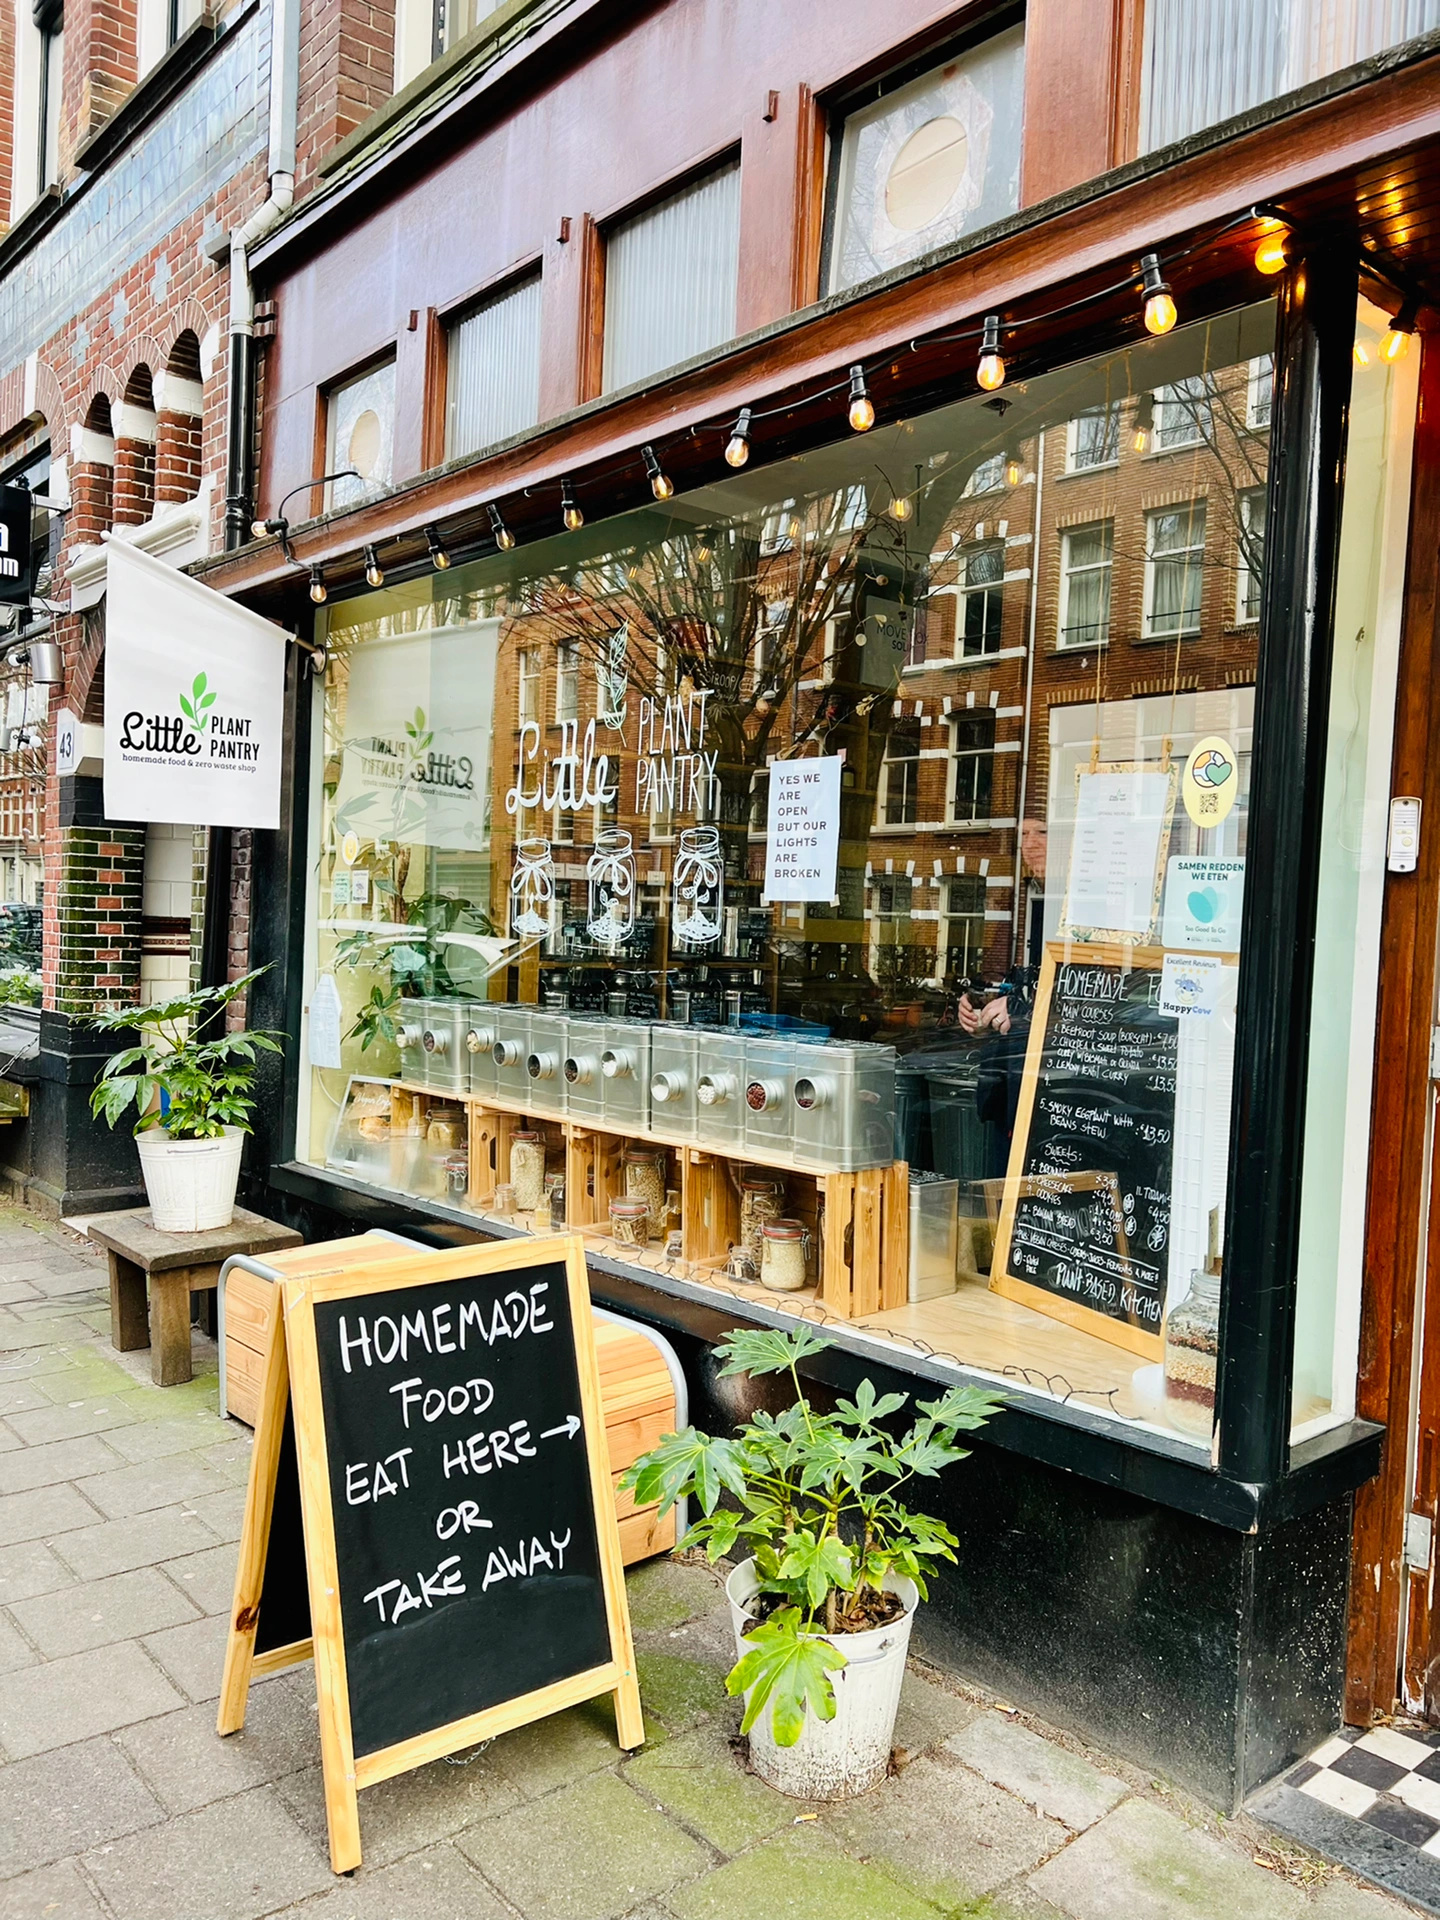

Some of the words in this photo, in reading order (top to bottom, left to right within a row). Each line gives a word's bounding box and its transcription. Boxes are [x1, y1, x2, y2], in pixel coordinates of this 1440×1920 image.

[211, 715, 252, 737] PLANT
[638, 689, 715, 756] PLANT
[119, 711, 202, 755] Little
[210, 739, 260, 761] PANTRY
[59, 732, 72, 759] 43
[122, 753, 167, 765] homemade
[168, 757, 186, 767] food
[188, 759, 194, 767] &
[195, 760, 213, 769] zero
[213, 763, 237, 771] waste
[238, 763, 257, 774] shop
[505, 717, 616, 815] Little
[635, 749, 719, 814] PANTRY
[779, 774, 800, 785] YES
[803, 773, 821, 783] WE
[778, 790, 801, 801] ARE
[777, 806, 808, 817] OPEN
[777, 822, 800, 832] BUT
[803, 821, 827, 831] OUR
[776, 837, 818, 848] LIGHTS
[775, 853, 798, 863] ARE
[774, 868, 821, 878] BROKEN
[1177, 862, 1207, 872] SAMEN
[1208, 862, 1244, 872] REDDEN
[1191, 872, 1207, 881] WE
[1208, 872, 1229, 881] ETEN
[1185, 925, 1194, 933] Too
[1194, 925, 1210, 934] Good
[1218, 926, 1227, 935] Go
[1166, 957, 1192, 967] Excellent
[1192, 959, 1217, 969] Reviews
[1057, 965, 1129, 1001] HOMEMADE
[1060, 1004, 1079, 1019] MAIN
[1081, 1005, 1114, 1022] COURSES
[1163, 1002, 1212, 1016] HappyCow
[1051, 1035, 1059, 1046] 2.
[1101, 1068, 1129, 1086] CURRY
[1047, 1100, 1073, 1117] SMOKY
[1050, 1114, 1077, 1131] BEANS
[338, 1282, 555, 1374] HOMEMADE
[388, 1376, 495, 1429] FOOD
[345, 1447, 414, 1506] EAT
[442, 1419, 537, 1479] HERE
[435, 1500, 493, 1540] OR
[362, 1554, 466, 1624] TAKE
[481, 1527, 572, 1592] AWAY
